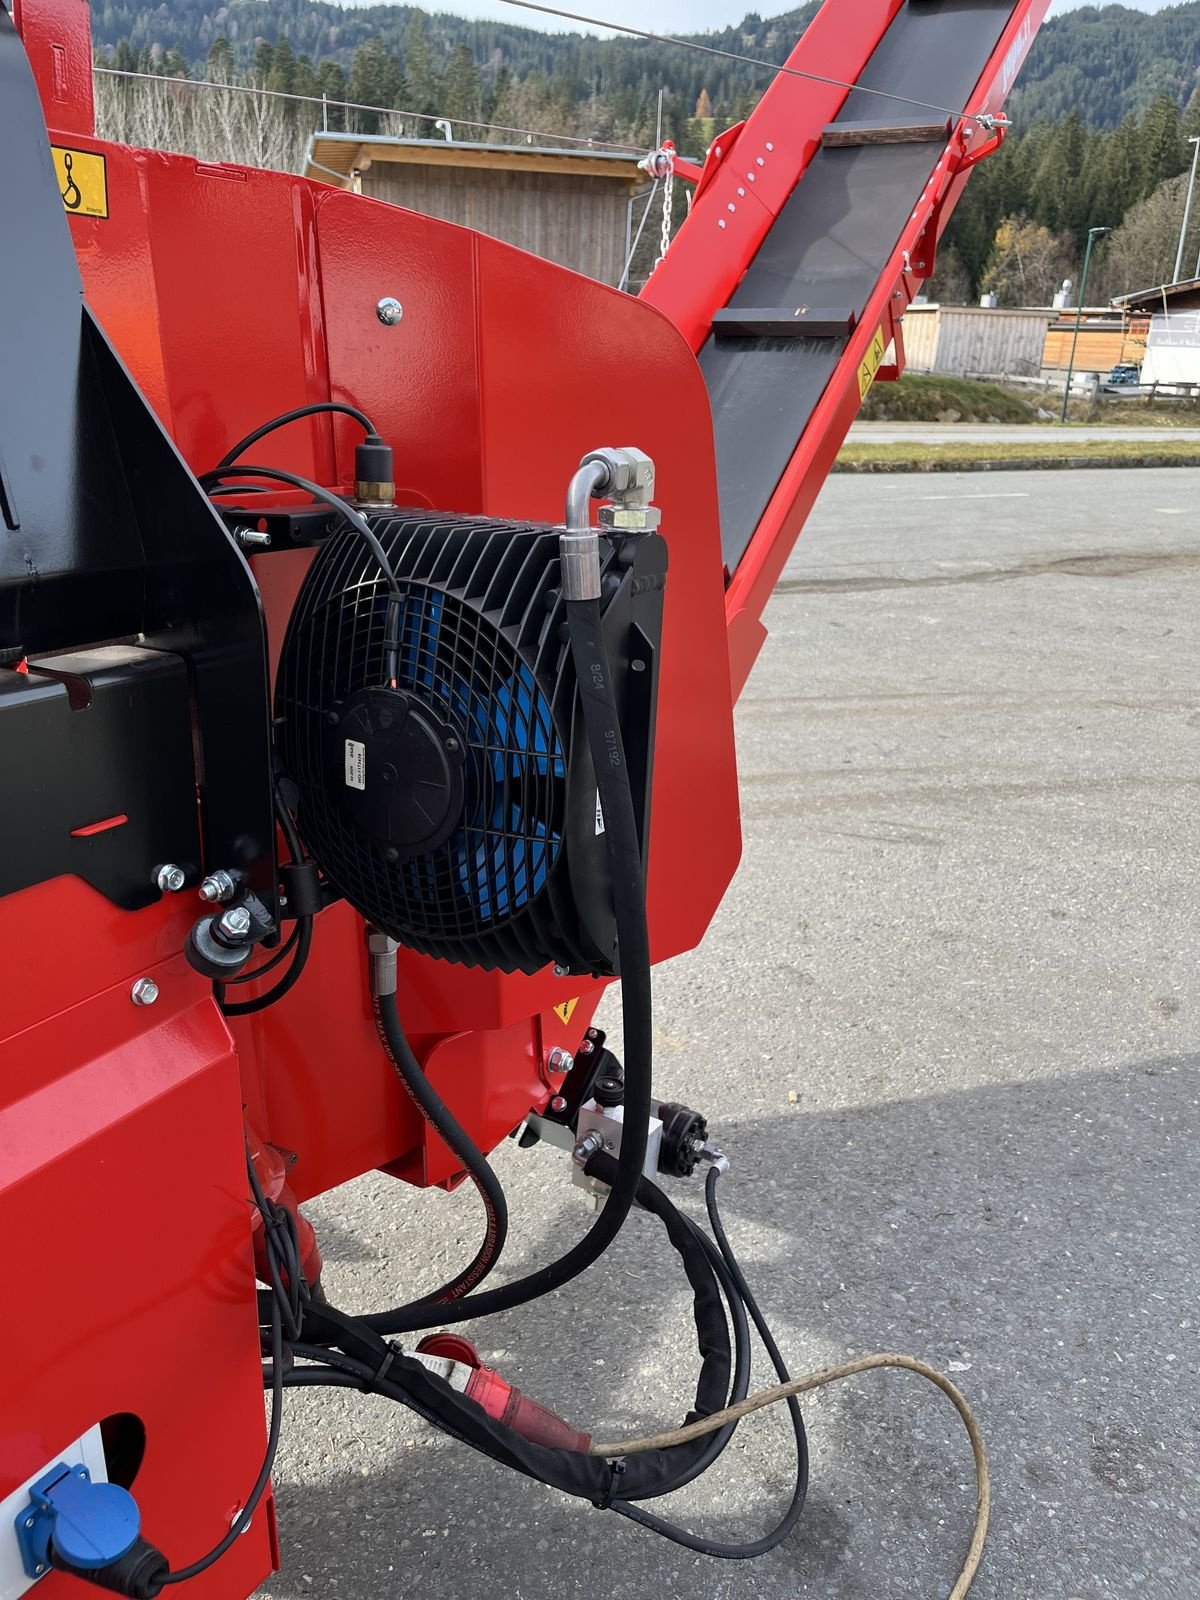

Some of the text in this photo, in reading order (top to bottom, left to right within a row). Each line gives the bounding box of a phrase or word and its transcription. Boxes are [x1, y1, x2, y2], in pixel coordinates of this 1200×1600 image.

[590, 663, 621, 767] 8/24 97192
[480, 1229, 496, 1264] ABRASION
[450, 1262, 486, 1297] RESISTANT
